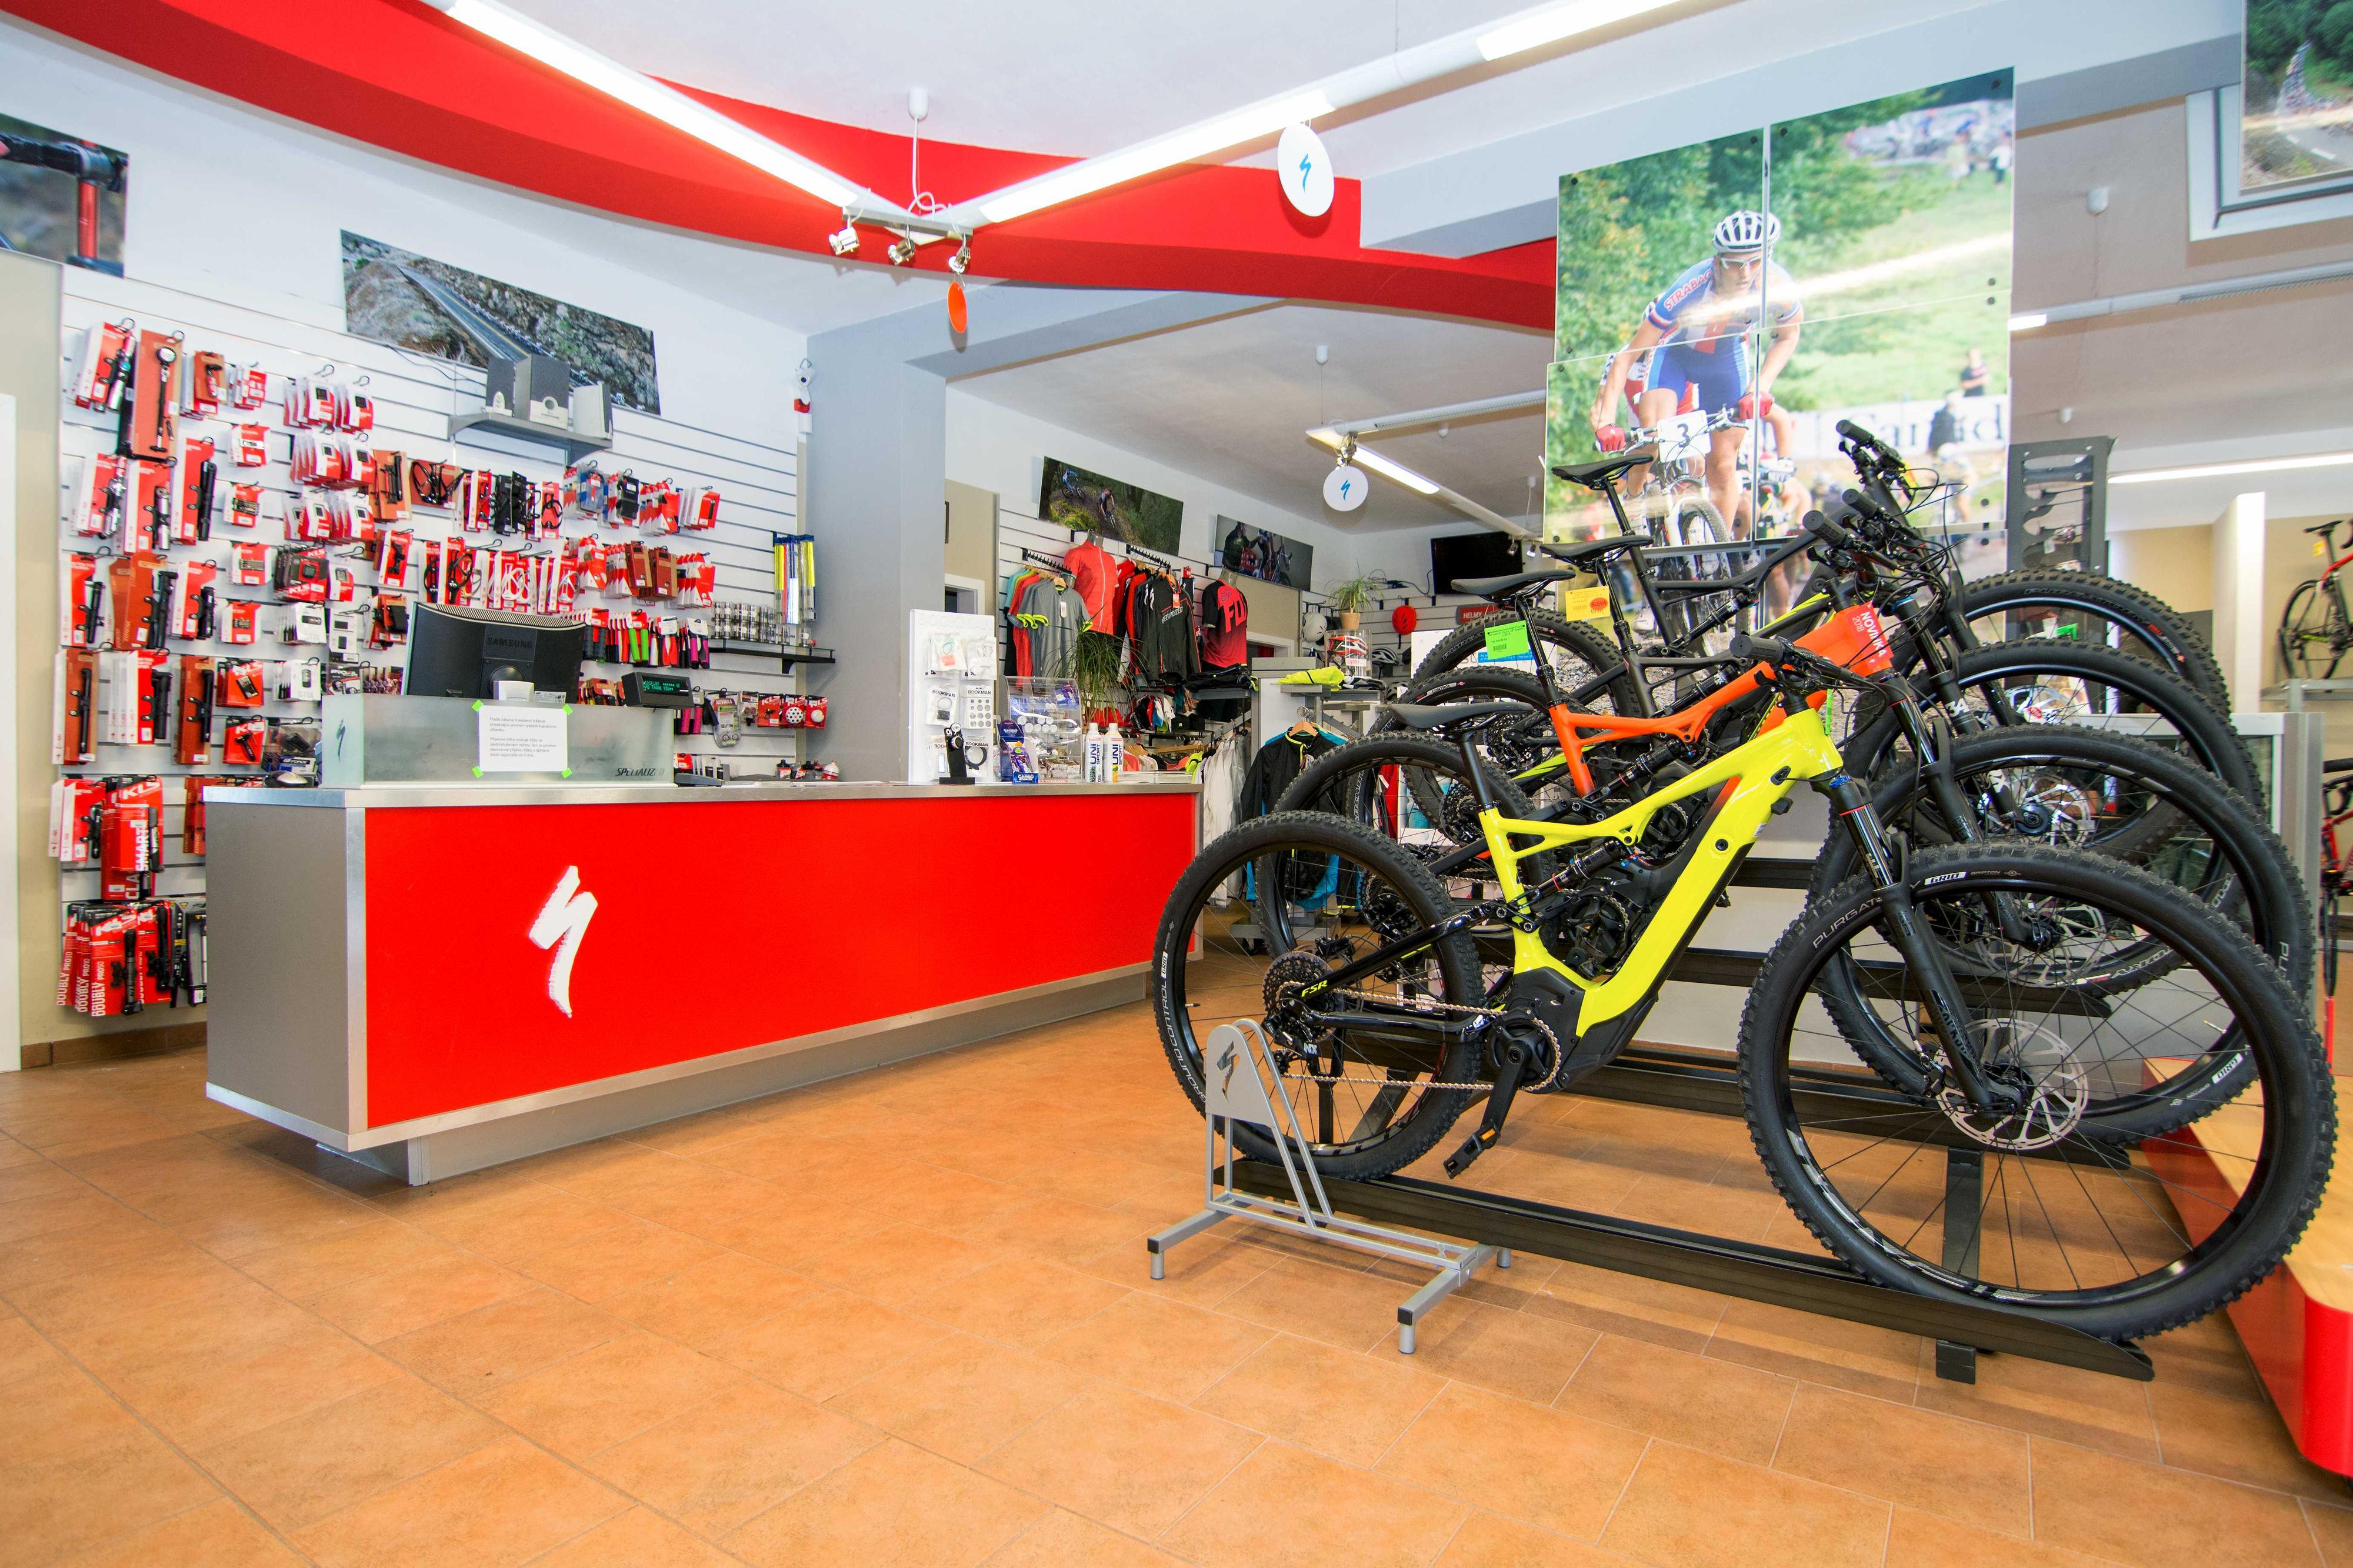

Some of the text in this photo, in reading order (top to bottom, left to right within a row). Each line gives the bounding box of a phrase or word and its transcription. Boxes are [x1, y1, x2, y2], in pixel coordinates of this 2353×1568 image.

[1664, 269, 1712, 311] STRABAG
[1678, 423, 1689, 448] 3
[289, 583, 311, 594] KLS
[1852, 616, 1865, 632] 2018
[487, 637, 532, 648] SAMSUNG
[1860, 612, 1887, 658] NOVINKA
[762, 695, 781, 705] KLS
[1945, 698, 1970, 717] 34
[122, 781, 161, 800] KLS
[135, 826, 149, 871] SMART
[1930, 873, 1959, 883] GRID
[57, 952, 73, 1005] DOUBLY PRO30
[77, 958, 91, 1012] DOUBLY PRO10
[93, 961, 106, 1016] DOUBLY PRO50
[1301, 980, 1328, 997] FSR
[1161, 980, 1177, 1047] CONTROL
[1304, 1042, 1318, 1055] NX
